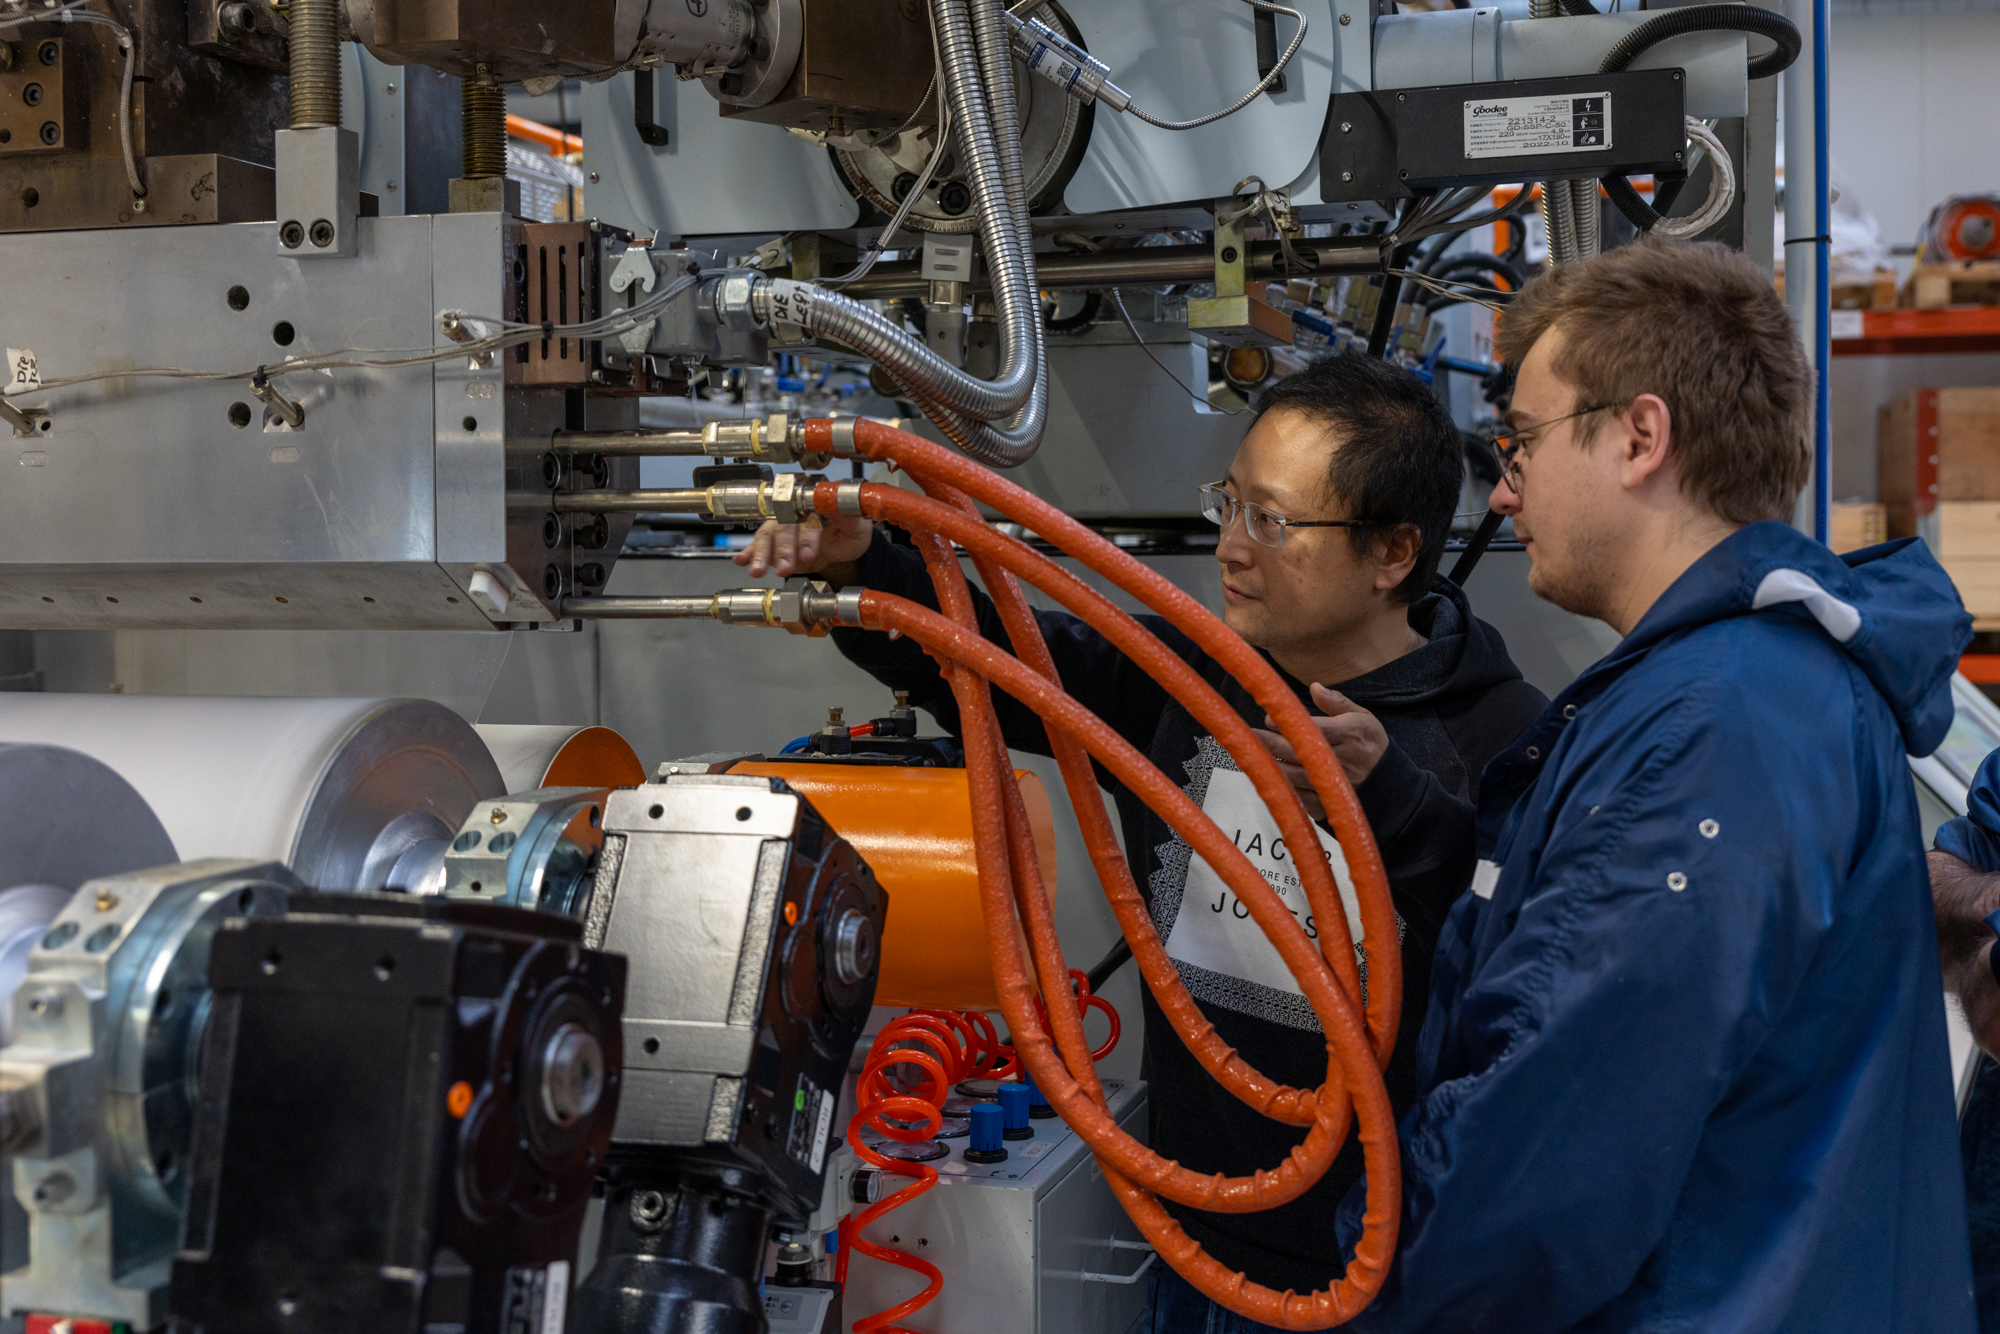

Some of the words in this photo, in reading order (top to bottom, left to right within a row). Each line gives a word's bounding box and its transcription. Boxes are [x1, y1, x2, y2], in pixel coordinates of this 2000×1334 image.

[1507, 115, 1556, 126] 221314-2
[1522, 140, 1569, 148] 2022-10
[1233, 828, 1297, 865] JAC
[1254, 866, 1281, 882] ORE
[1211, 891, 1319, 939] JOS
